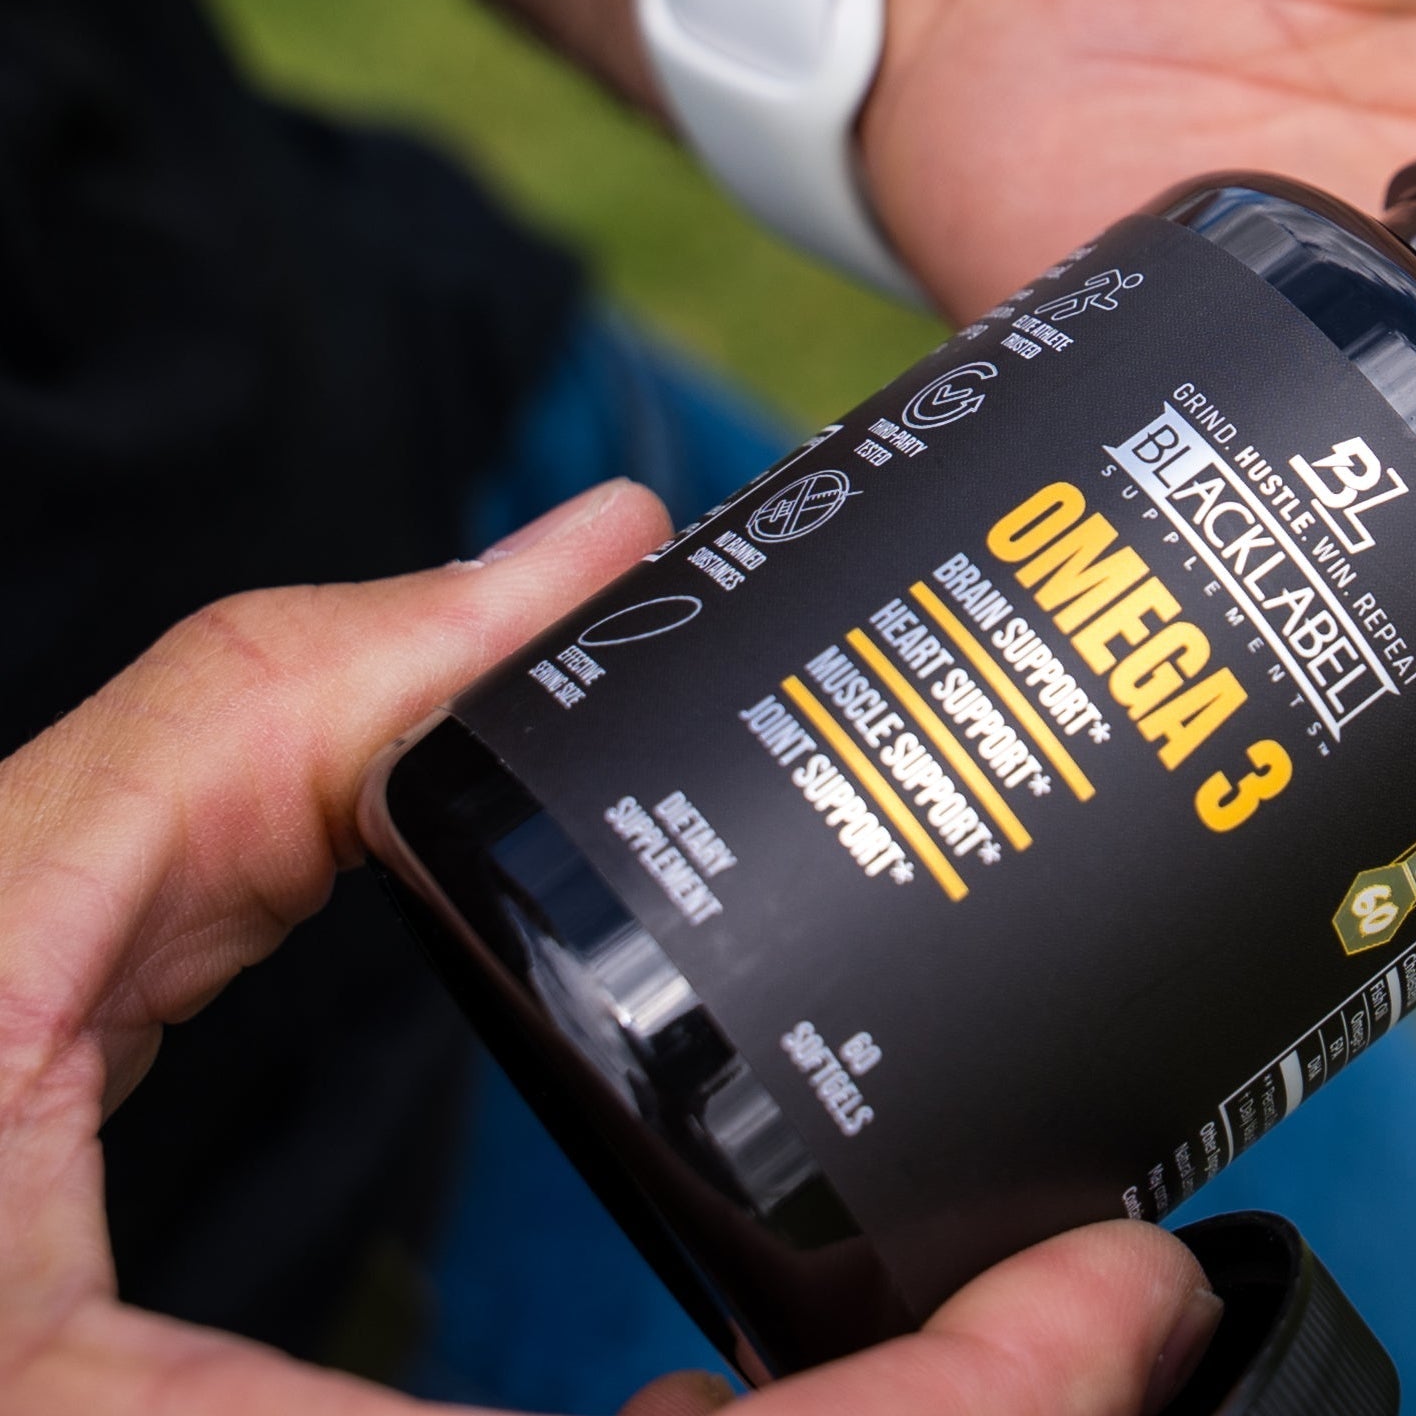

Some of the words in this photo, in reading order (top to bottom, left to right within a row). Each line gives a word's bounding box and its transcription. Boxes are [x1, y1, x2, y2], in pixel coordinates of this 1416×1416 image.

[1000, 332, 1043, 360] TRUSTED
[1012, 314, 1042, 333] ELITE
[1029, 323, 1074, 352] ATHLETE
[853, 438, 893, 467] TESTED
[868, 417, 928, 457] THIRD-PARTY
[1173, 382, 1238, 451] GRIND.
[1234, 445, 1316, 542] HUSTLE.
[1311, 535, 1357, 596] WIN.
[714, 530, 737, 547] NO
[723, 536, 767, 570] BANNED
[687, 546, 746, 591] SUBSTANCES
[1132, 423, 1371, 715] BLACKLABEL
[933, 552, 1014, 631] BRAIN
[869, 598, 955, 679] HEART
[986, 481, 1248, 771] OMEGA
[1194, 739, 1293, 832] 3
[528, 659, 569, 692] SERVING
[555, 681, 586, 708] SIZE
[557, 645, 606, 685] EFFECTIVE
[806, 645, 905, 748] MUSCLE
[740, 695, 817, 766] JOINT
[655, 791, 738, 876] DIETARY
[606, 796, 723, 924] SUPPLEMENT
[1351, 884, 1399, 938] 60
[1370, 979, 1387, 1008] Fish
[841, 1031, 882, 1074] 60
[1307, 1054, 1322, 1082] DHA
[1329, 1035, 1344, 1060] EPA
[782, 1021, 874, 1134] SOFTGELS
[1174, 1141, 1196, 1178] Natural
[1200, 1121, 1218, 1155] Other
[1147, 1163, 1164, 1190] May
